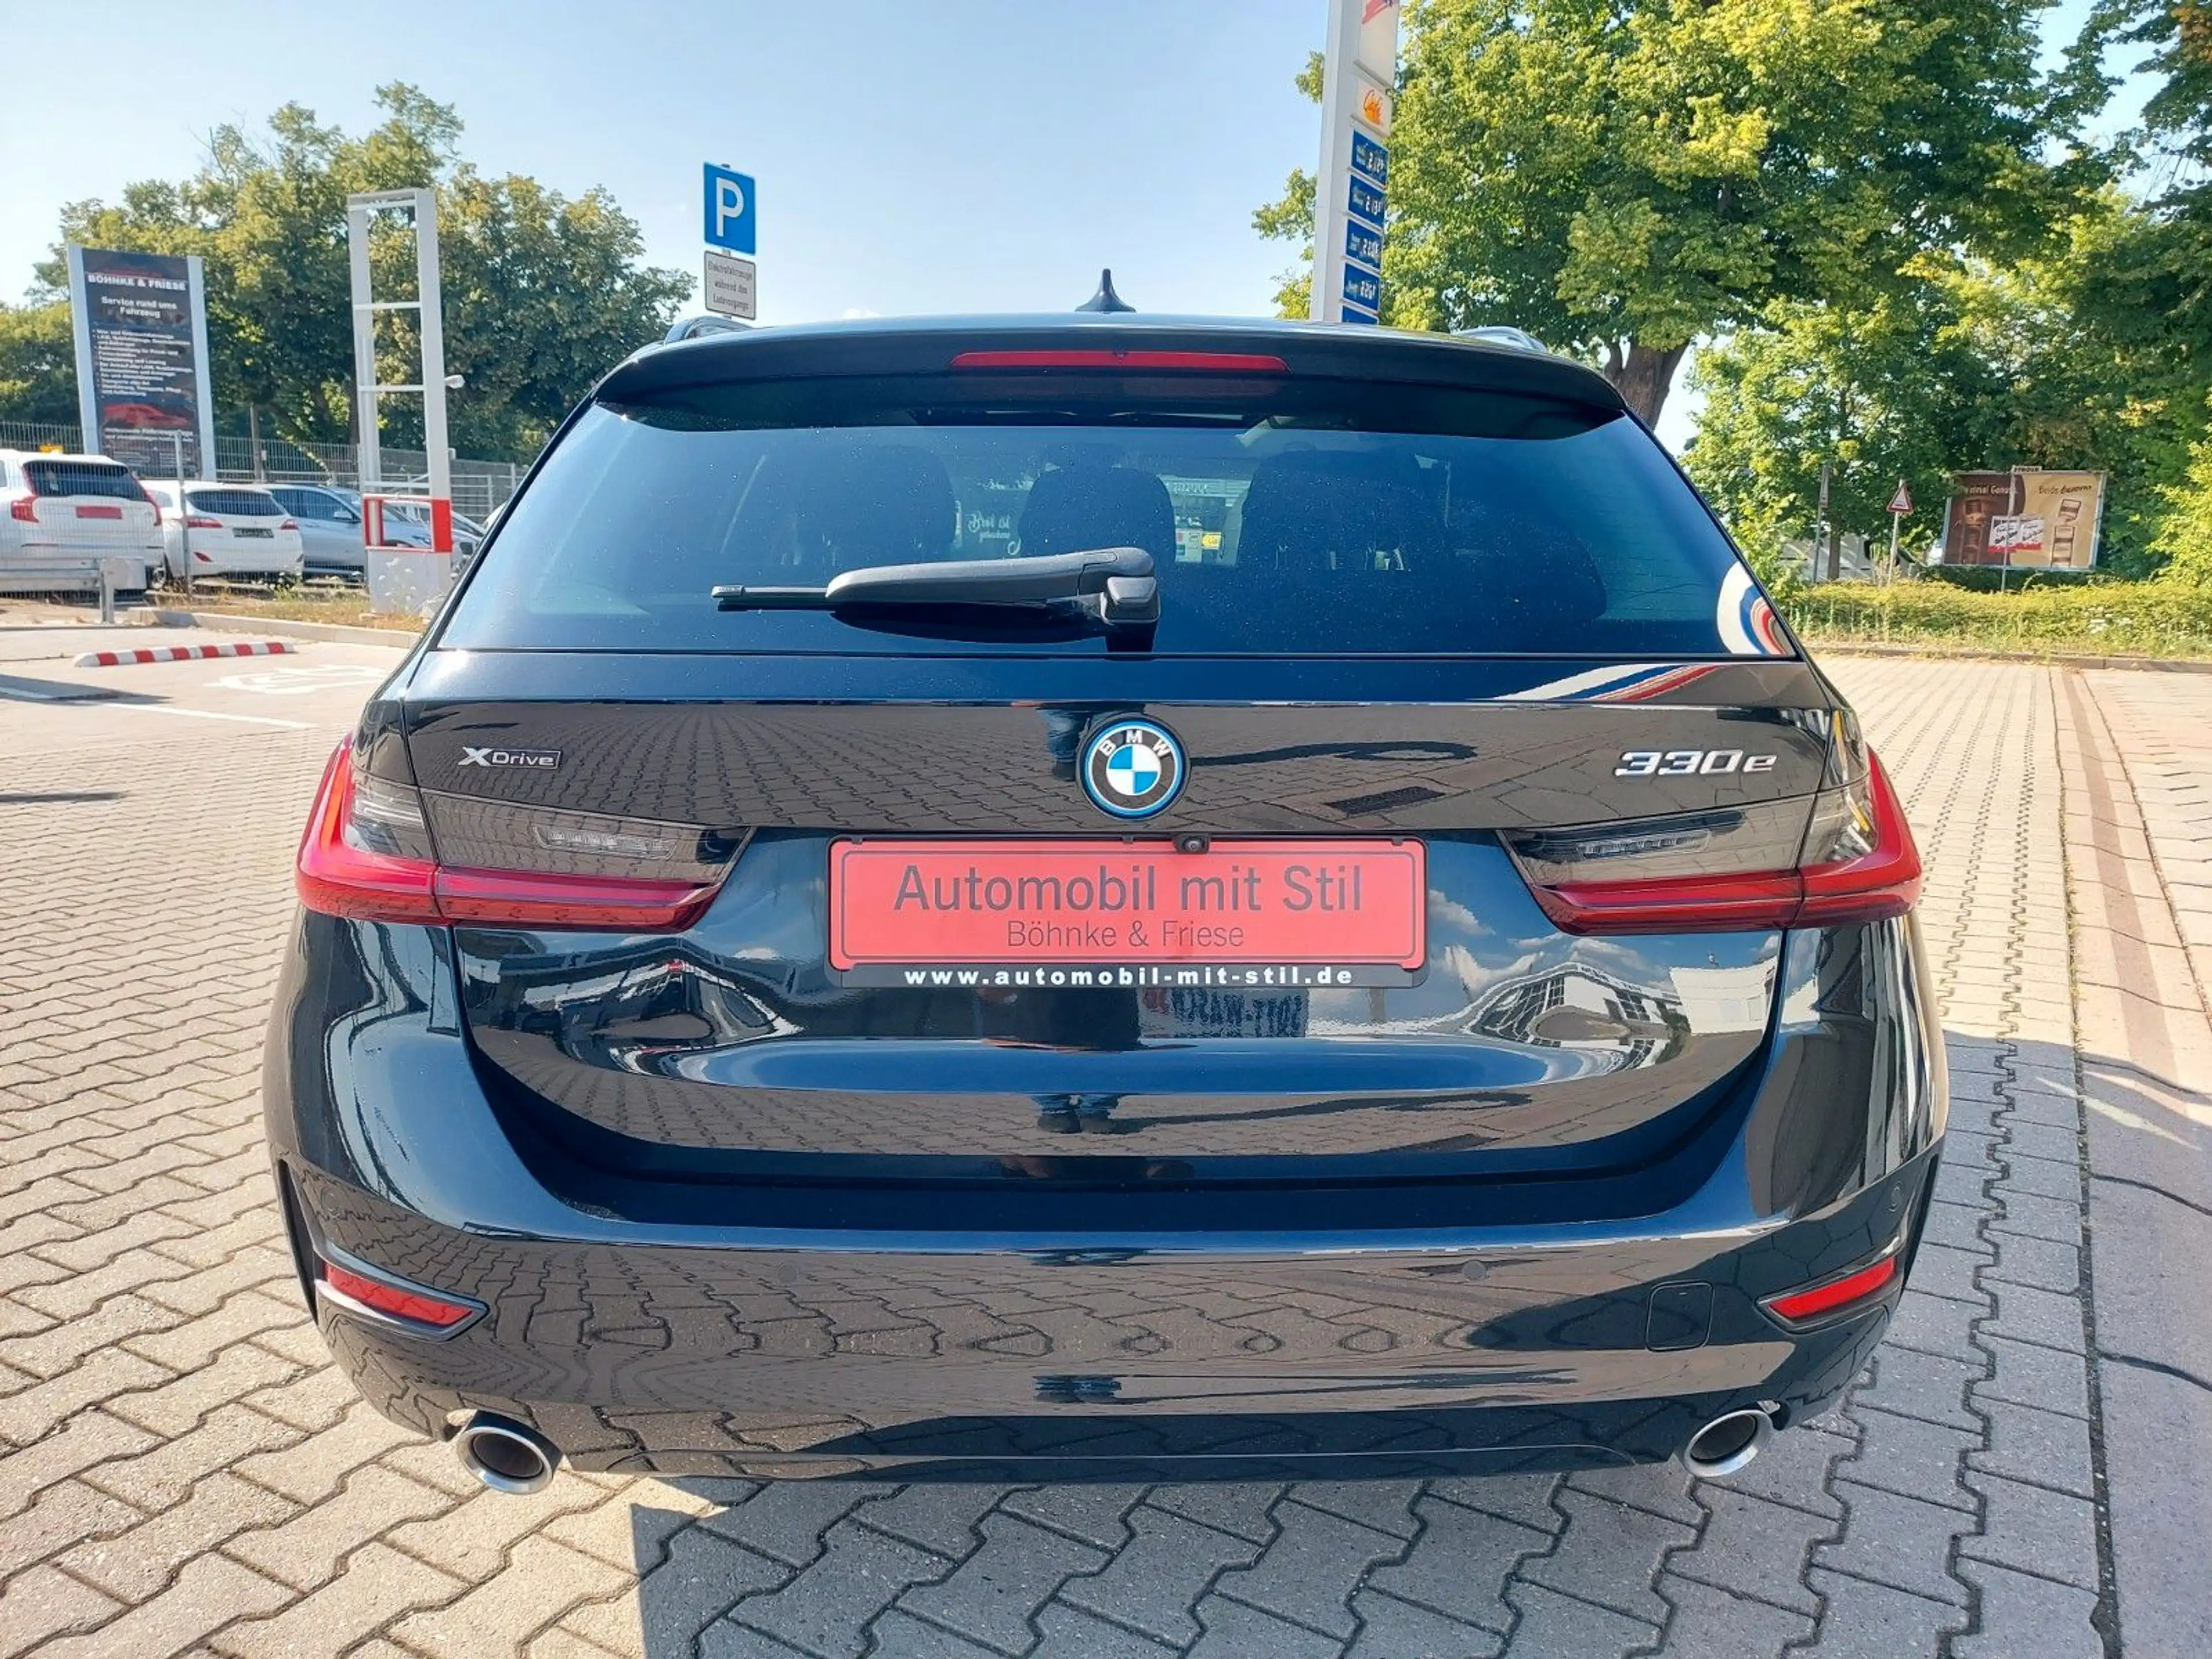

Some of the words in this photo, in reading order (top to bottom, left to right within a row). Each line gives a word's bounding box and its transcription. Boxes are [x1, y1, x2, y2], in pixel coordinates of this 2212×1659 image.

[716, 177, 744, 237] P
[138, 278, 146, 287] &
[149, 279, 186, 291] FRIESE
[101, 296, 134, 306] Service
[136, 299, 157, 309] rund
[120, 306, 161, 319] Fahrzeug
[1099, 730, 1171, 757] BMW
[1615, 749, 1778, 777] 330e
[895, 864, 1156, 911] Automobil
[1181, 864, 1262, 911] mit
[1282, 864, 1361, 911] Stil
[1007, 919, 1117, 948] Böhnke
[1128, 919, 1149, 948] &
[1162, 919, 1244, 948] Friese
[904, 967, 1353, 987] www.automobil-mit-stil.de
